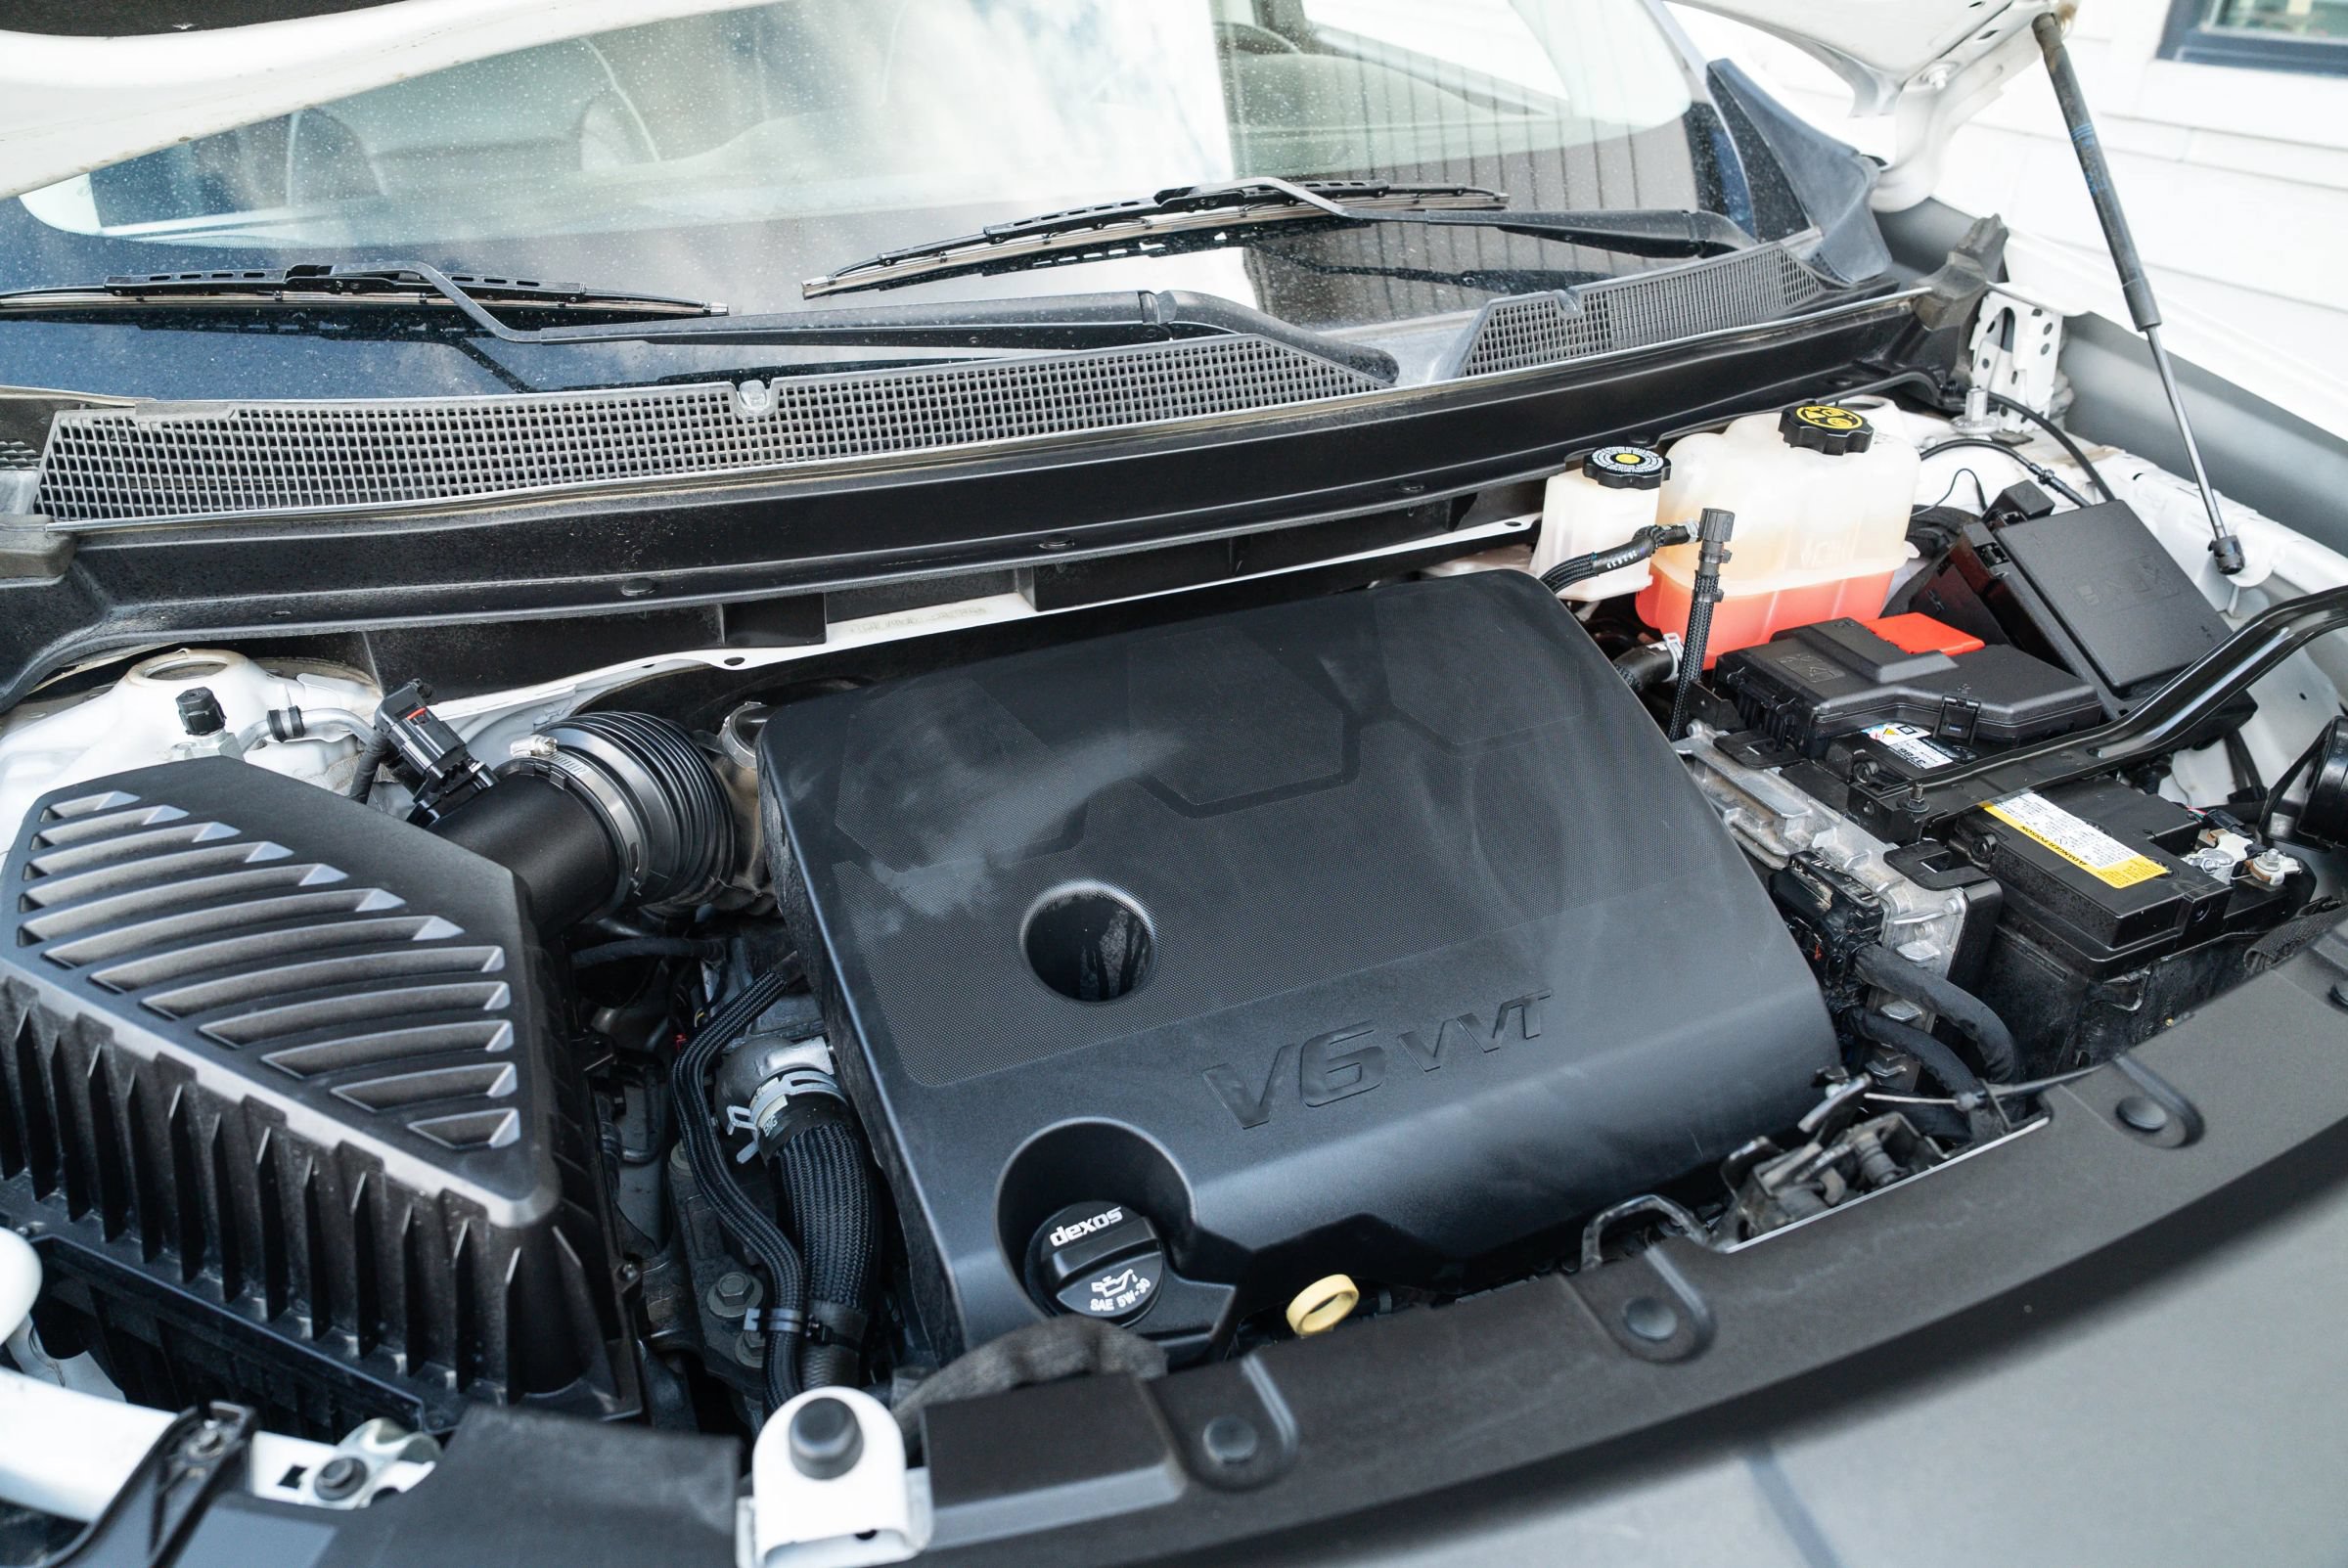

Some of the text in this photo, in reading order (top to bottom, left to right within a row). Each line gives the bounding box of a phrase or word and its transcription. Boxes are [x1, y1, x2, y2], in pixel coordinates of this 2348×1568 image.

[1202, 989, 1552, 1131] V6 VVT
[1050, 1206, 1123, 1247] dexos
[1090, 1277, 1151, 1312] SAE 5W-30
